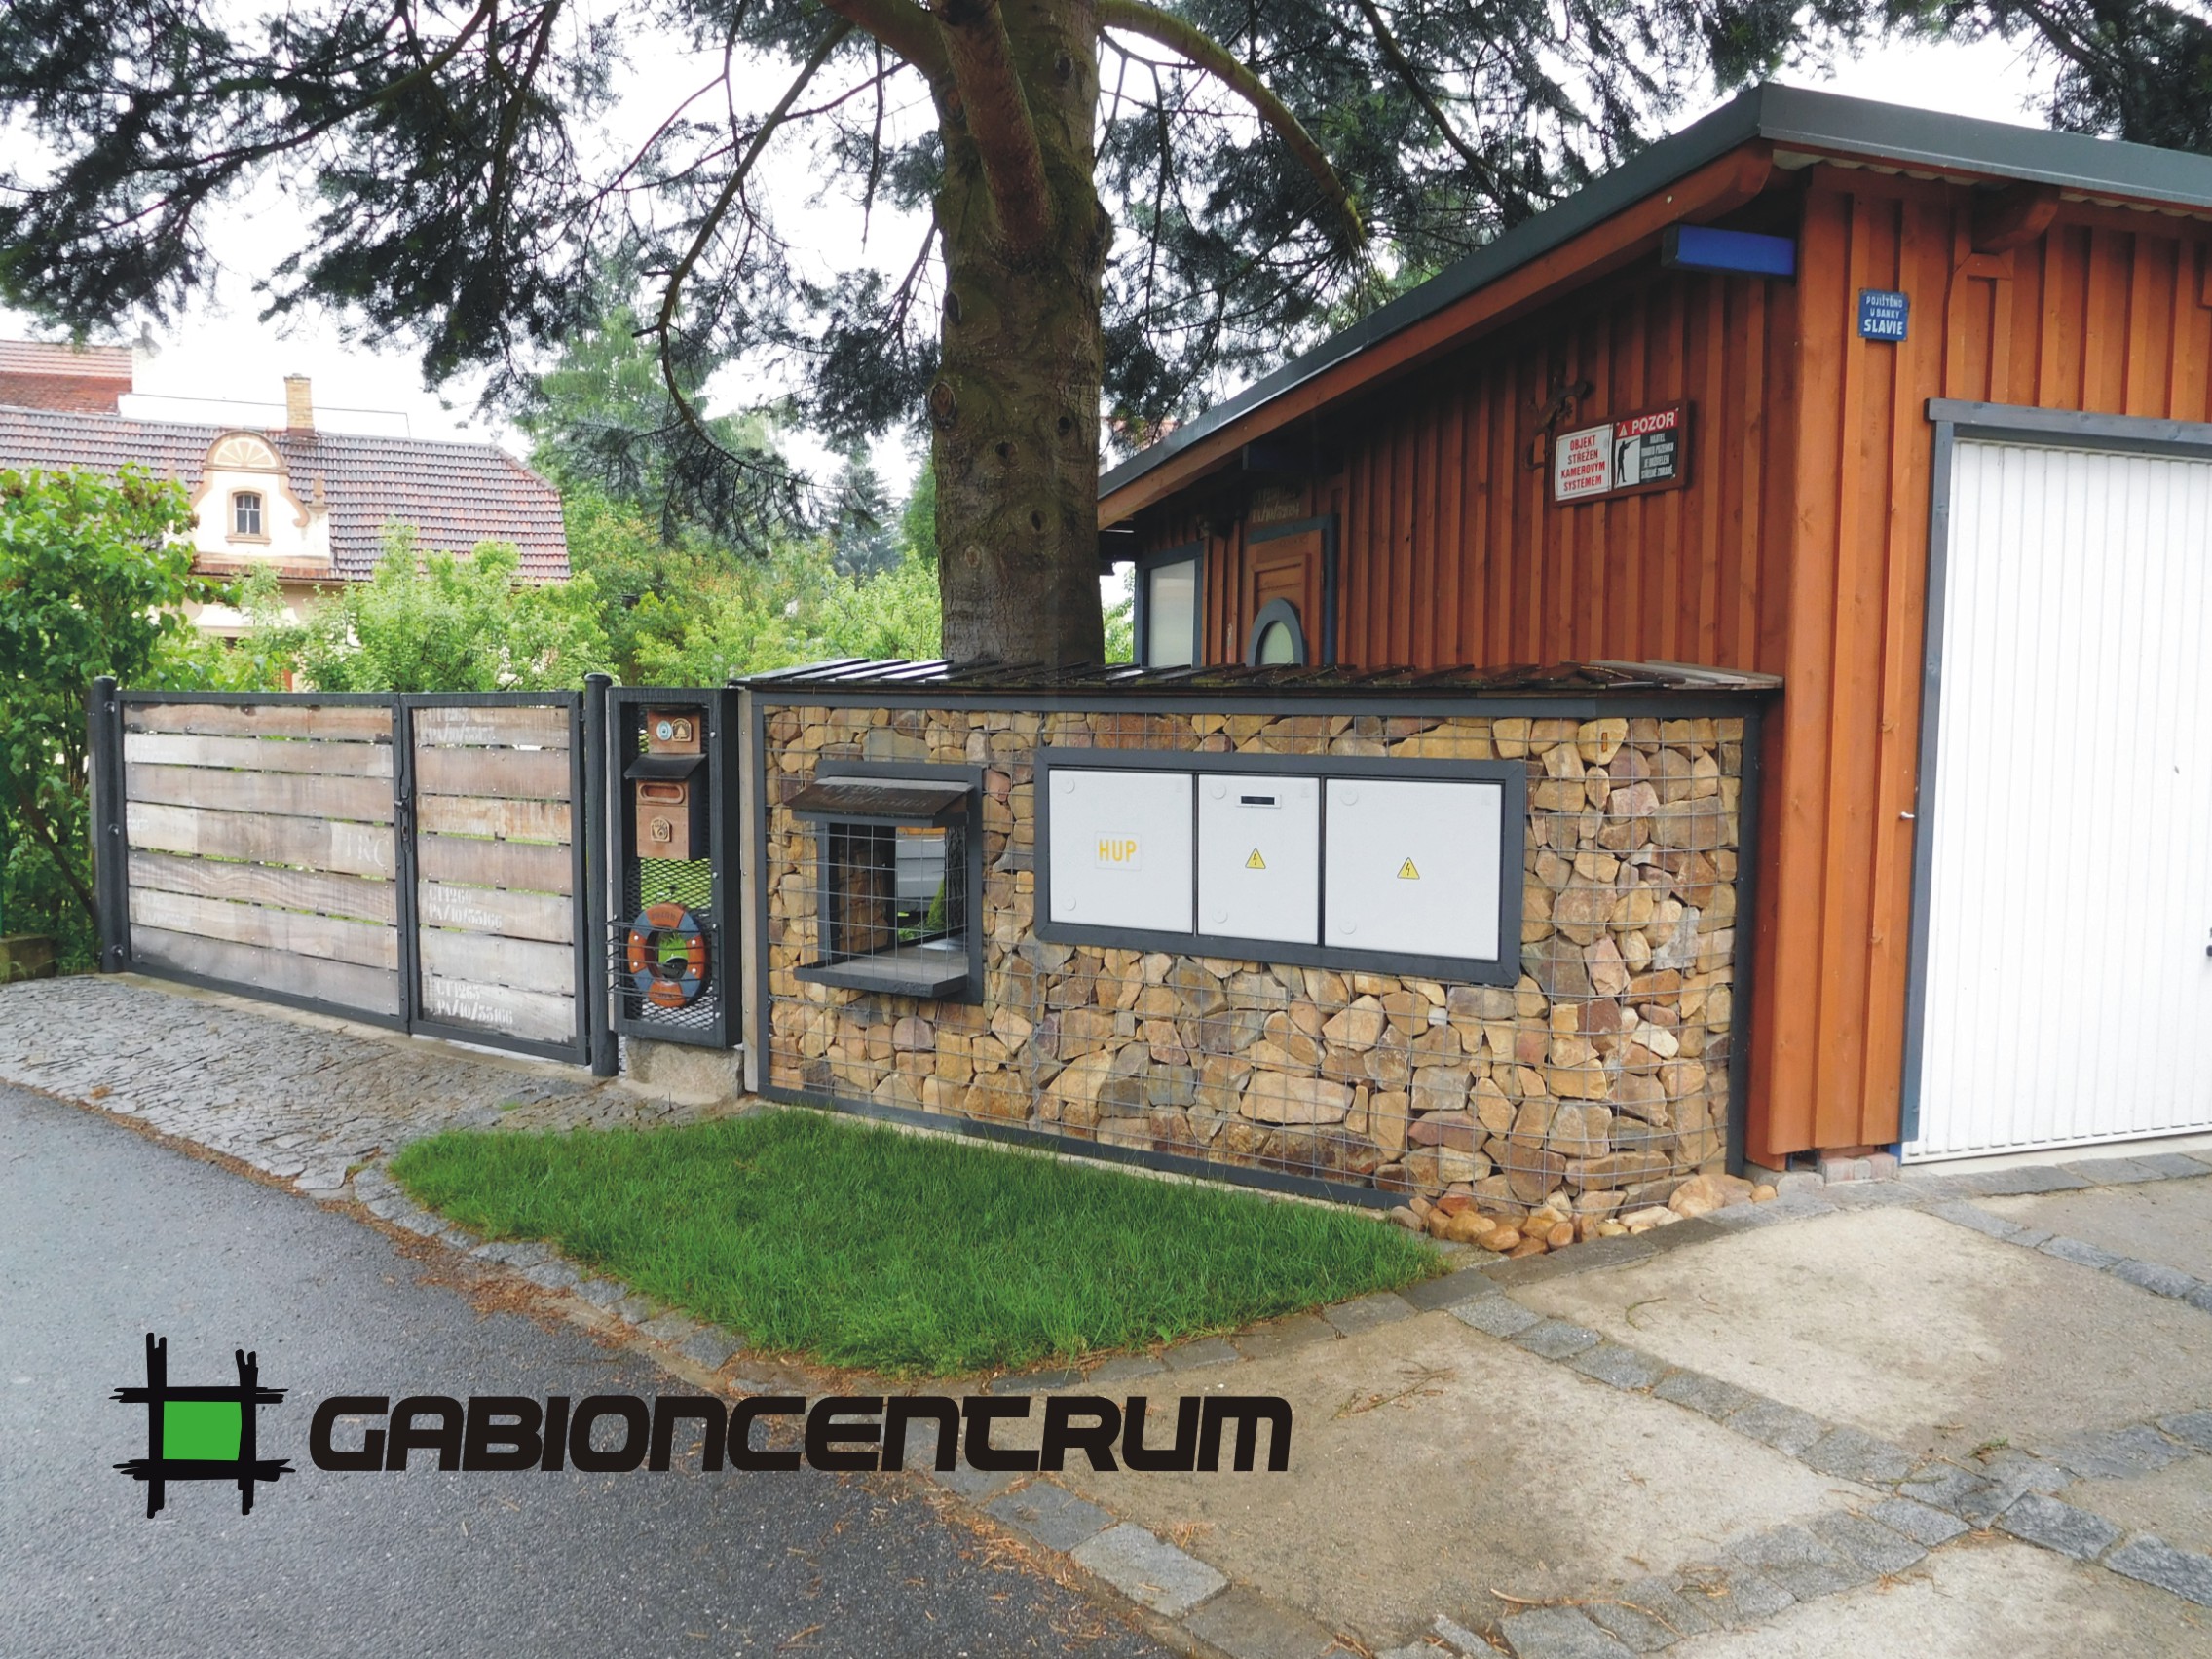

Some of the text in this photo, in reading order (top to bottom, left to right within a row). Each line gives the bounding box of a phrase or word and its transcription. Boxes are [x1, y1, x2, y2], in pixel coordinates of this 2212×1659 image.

[1870, 307, 1900, 319] U BANKY
[1863, 319, 1903, 335] SLAVIE
[1631, 412, 1675, 434] POZOR
[1569, 435, 1596, 451] OBJEKT
[1560, 460, 1605, 479] KAMEROVÝM
[1563, 474, 1602, 492] SYSTÉMEM
[1099, 839, 1137, 862] HUP
